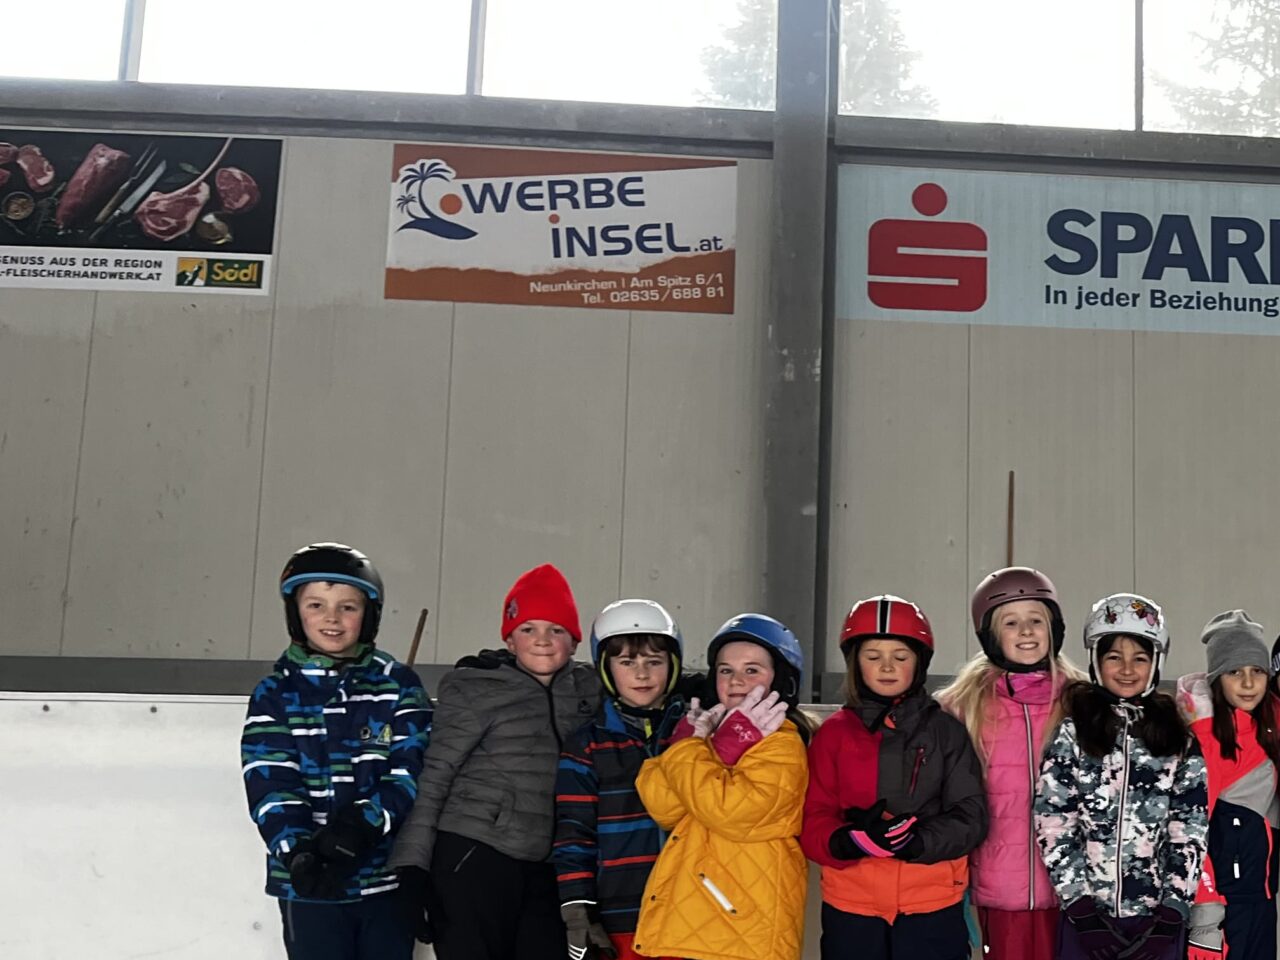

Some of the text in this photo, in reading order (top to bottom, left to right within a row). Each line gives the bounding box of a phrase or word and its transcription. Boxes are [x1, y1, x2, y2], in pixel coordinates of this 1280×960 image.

[462, 176, 646, 214] WERBE
[0, 255, 163, 269] ENUSS AUS DER REGION
[0, 268, 163, 281] -FLEISCHERHANDWERK.AT
[529, 278, 617, 294] Neunkirchen
[630, 276, 654, 289] Am
[657, 274, 692, 290] Spitz
[695, 273, 724, 287] 6/1
[582, 292, 605, 305] Tel.
[706, 286, 726, 300] 81
[1045, 285, 1068, 305] In
[1075, 285, 1141, 310] jeder
[1150, 288, 1280, 318] Beziehung
